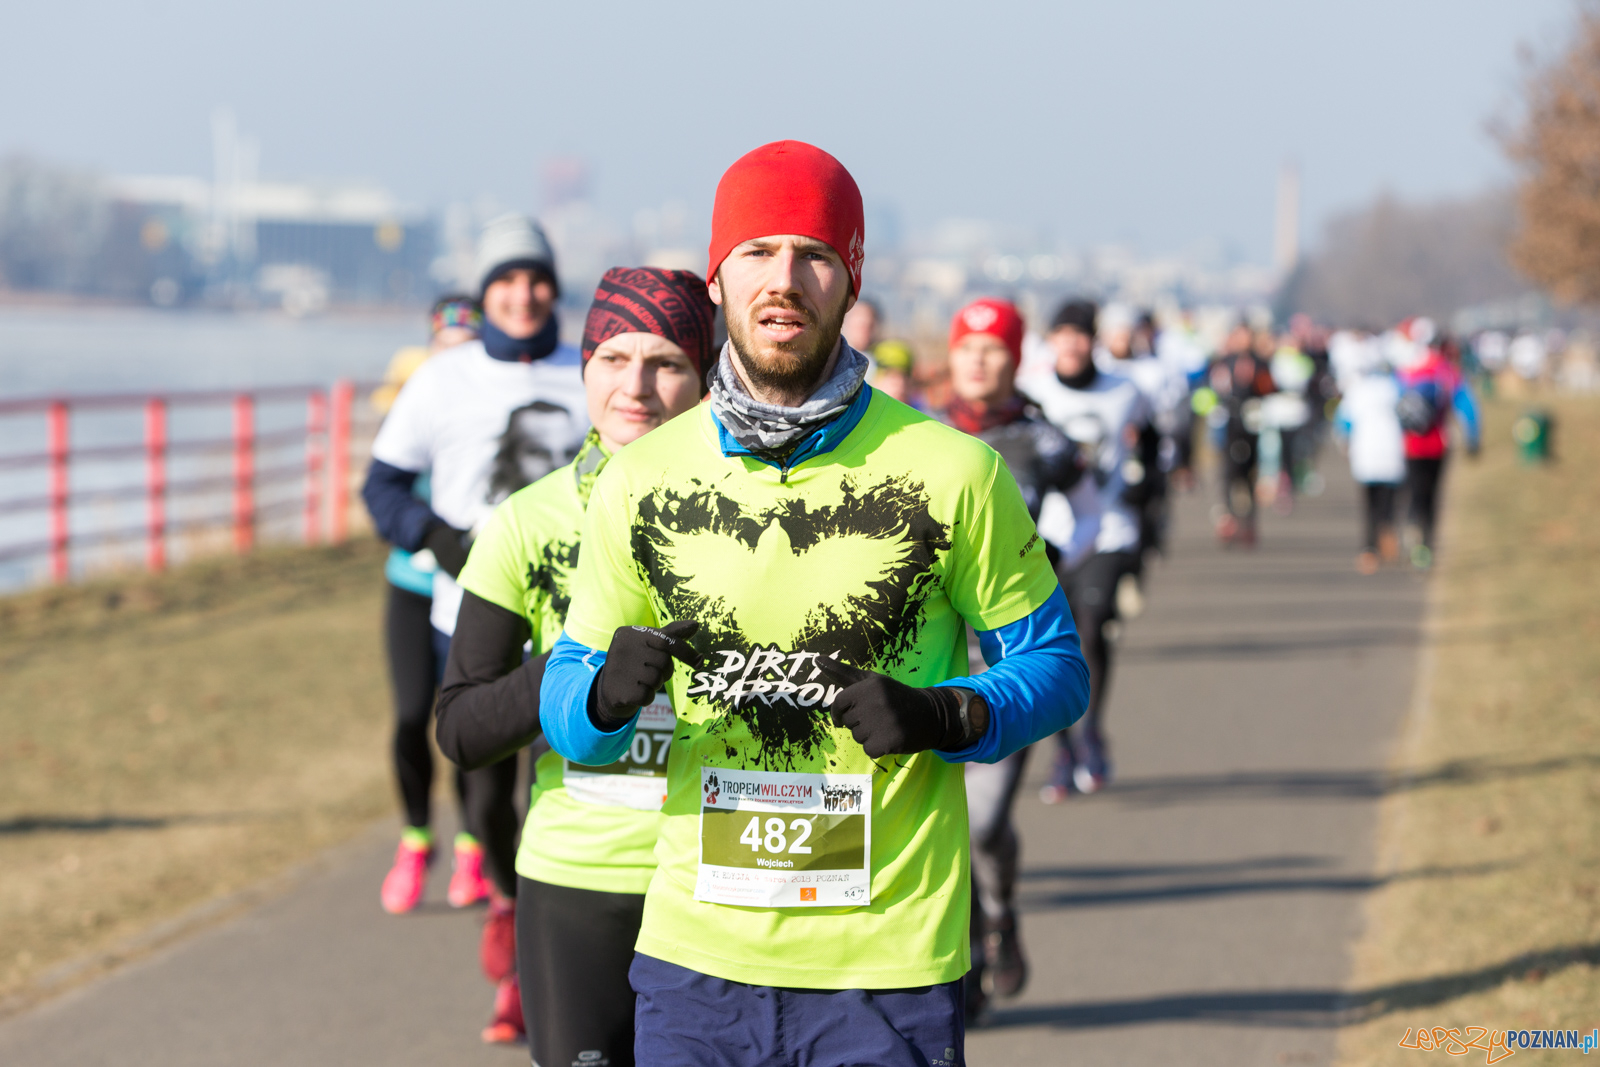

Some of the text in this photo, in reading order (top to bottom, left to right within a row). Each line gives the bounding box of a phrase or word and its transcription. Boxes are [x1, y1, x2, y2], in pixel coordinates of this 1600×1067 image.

[618, 731, 673, 765] 07
[739, 816, 812, 854] 482
[756, 857, 794, 869] Wojciech
[791, 875, 811, 883] 2018
